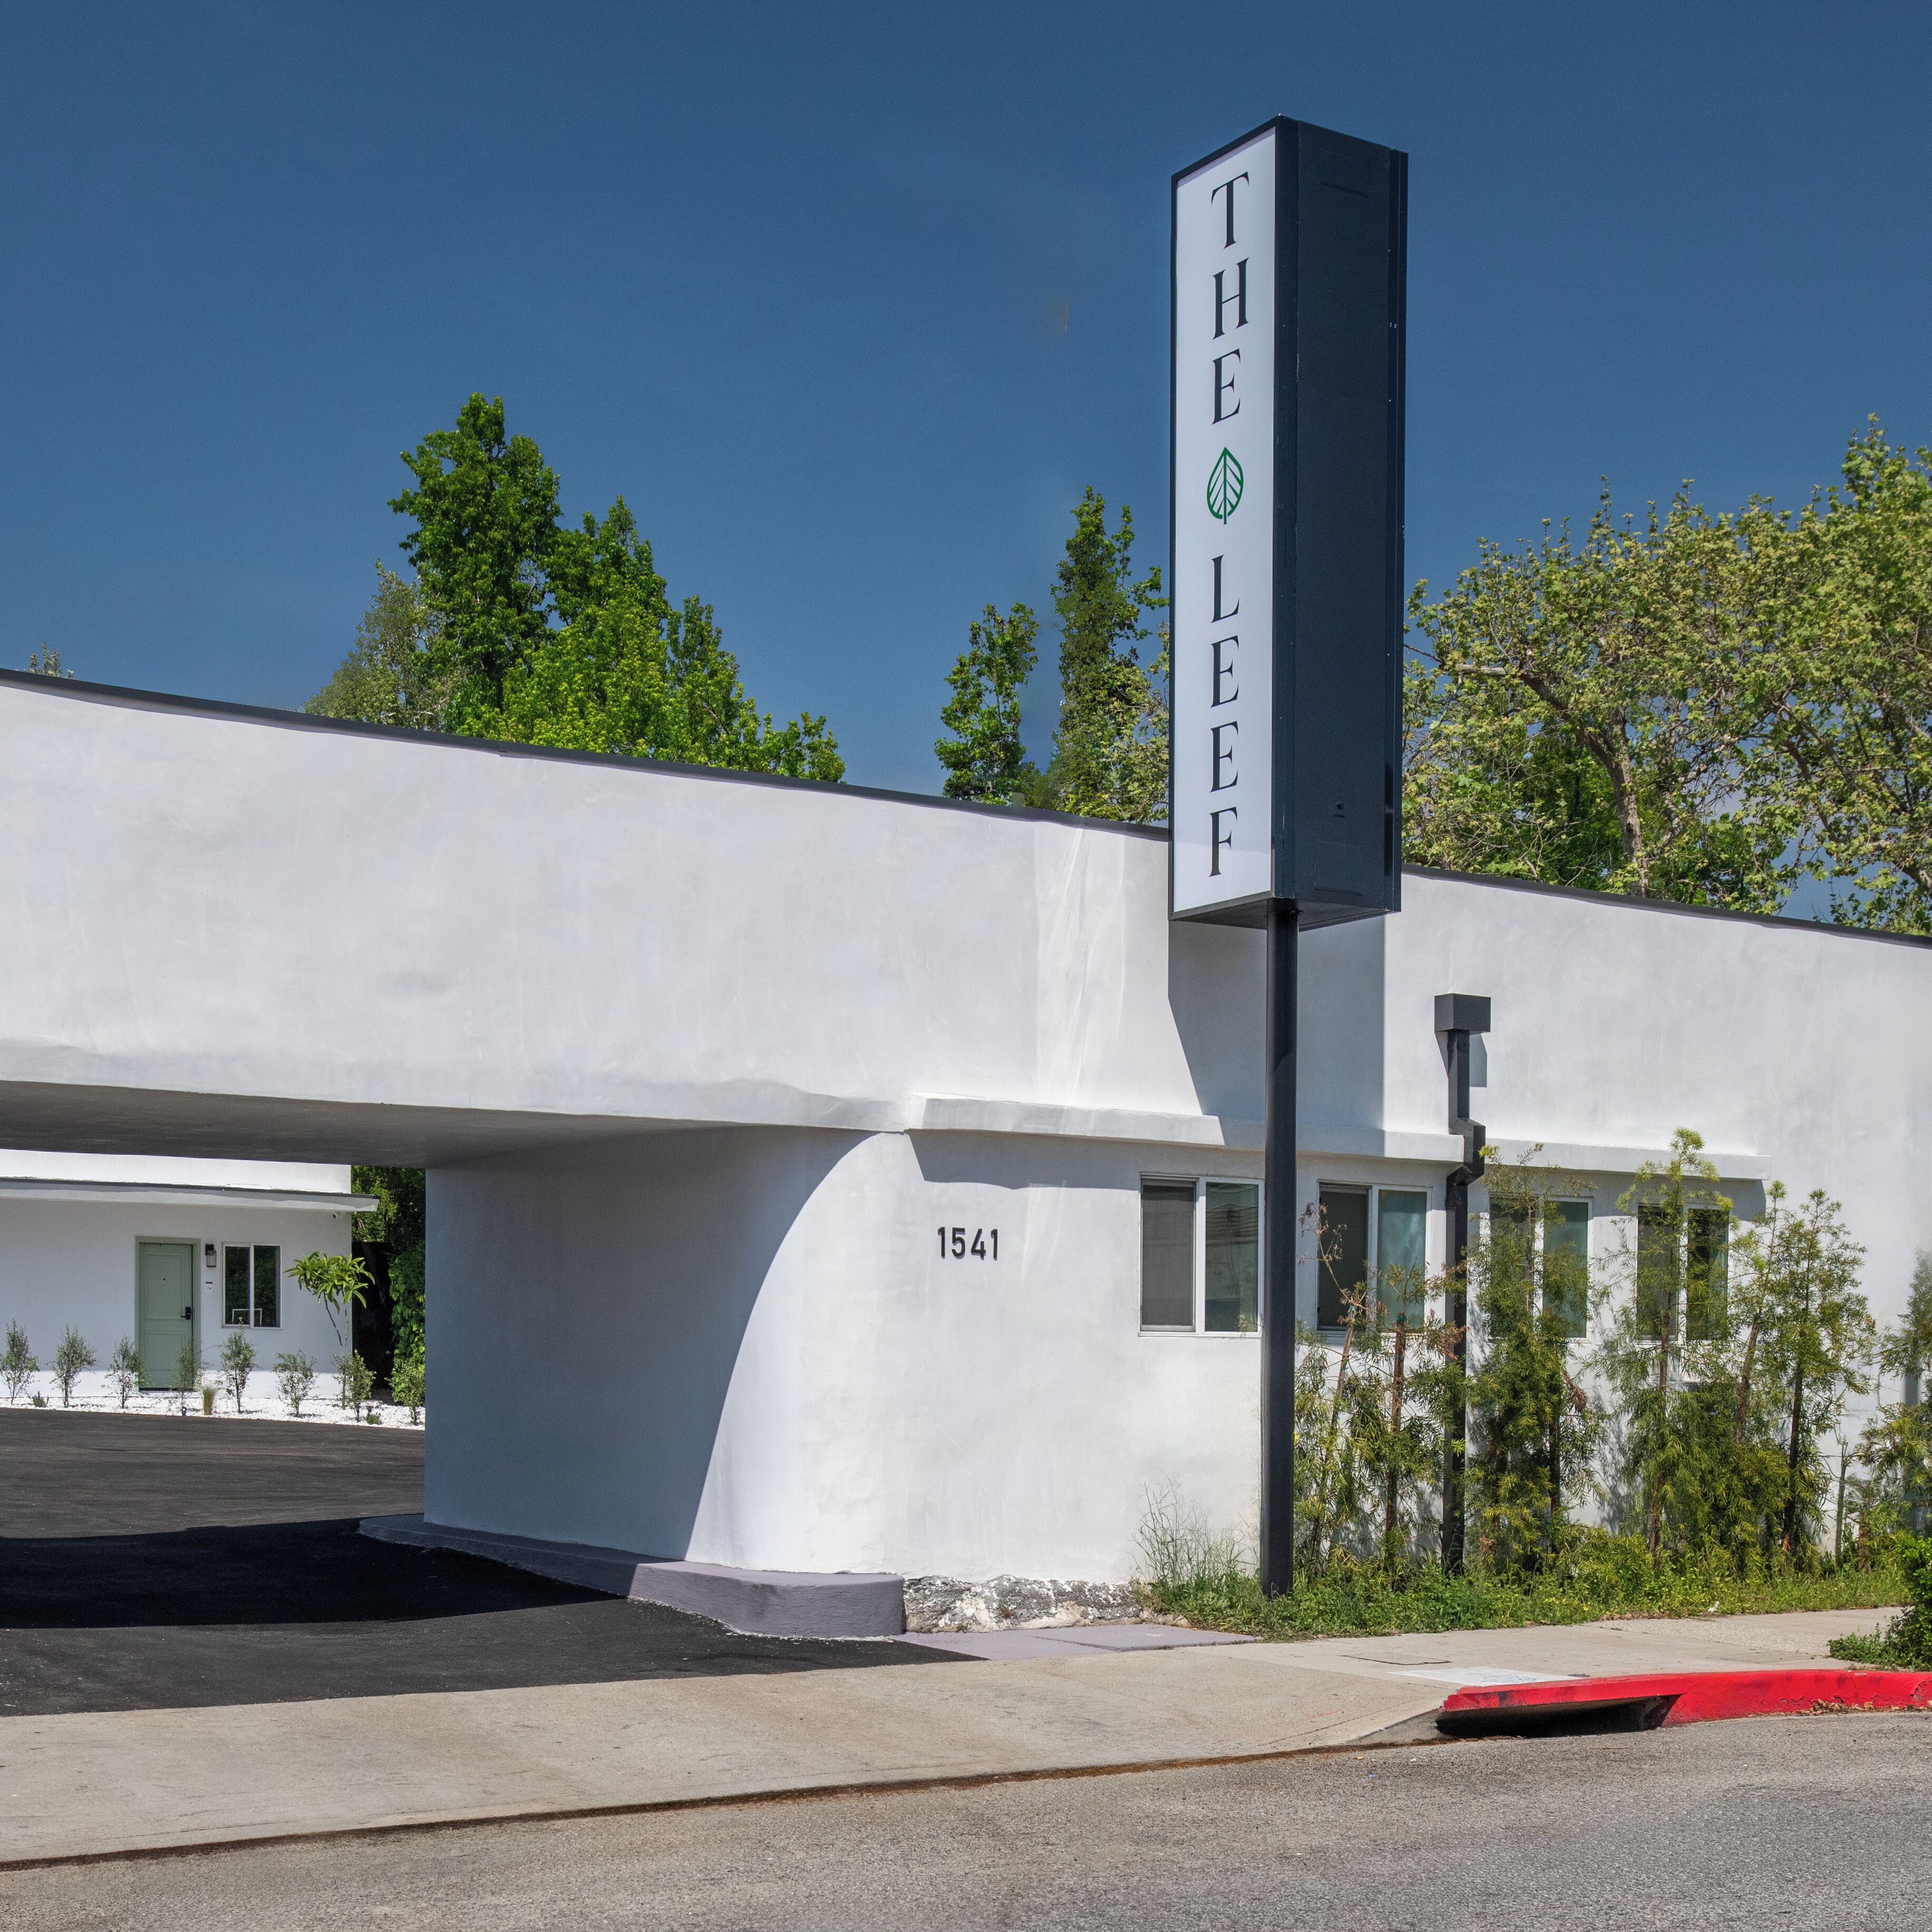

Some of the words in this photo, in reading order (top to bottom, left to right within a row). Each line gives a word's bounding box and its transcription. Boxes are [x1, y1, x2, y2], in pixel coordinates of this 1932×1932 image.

[1211, 171, 1250, 425] THE
[1209, 554, 1240, 877] LEEF
[937, 1227, 998, 1260] 1541
